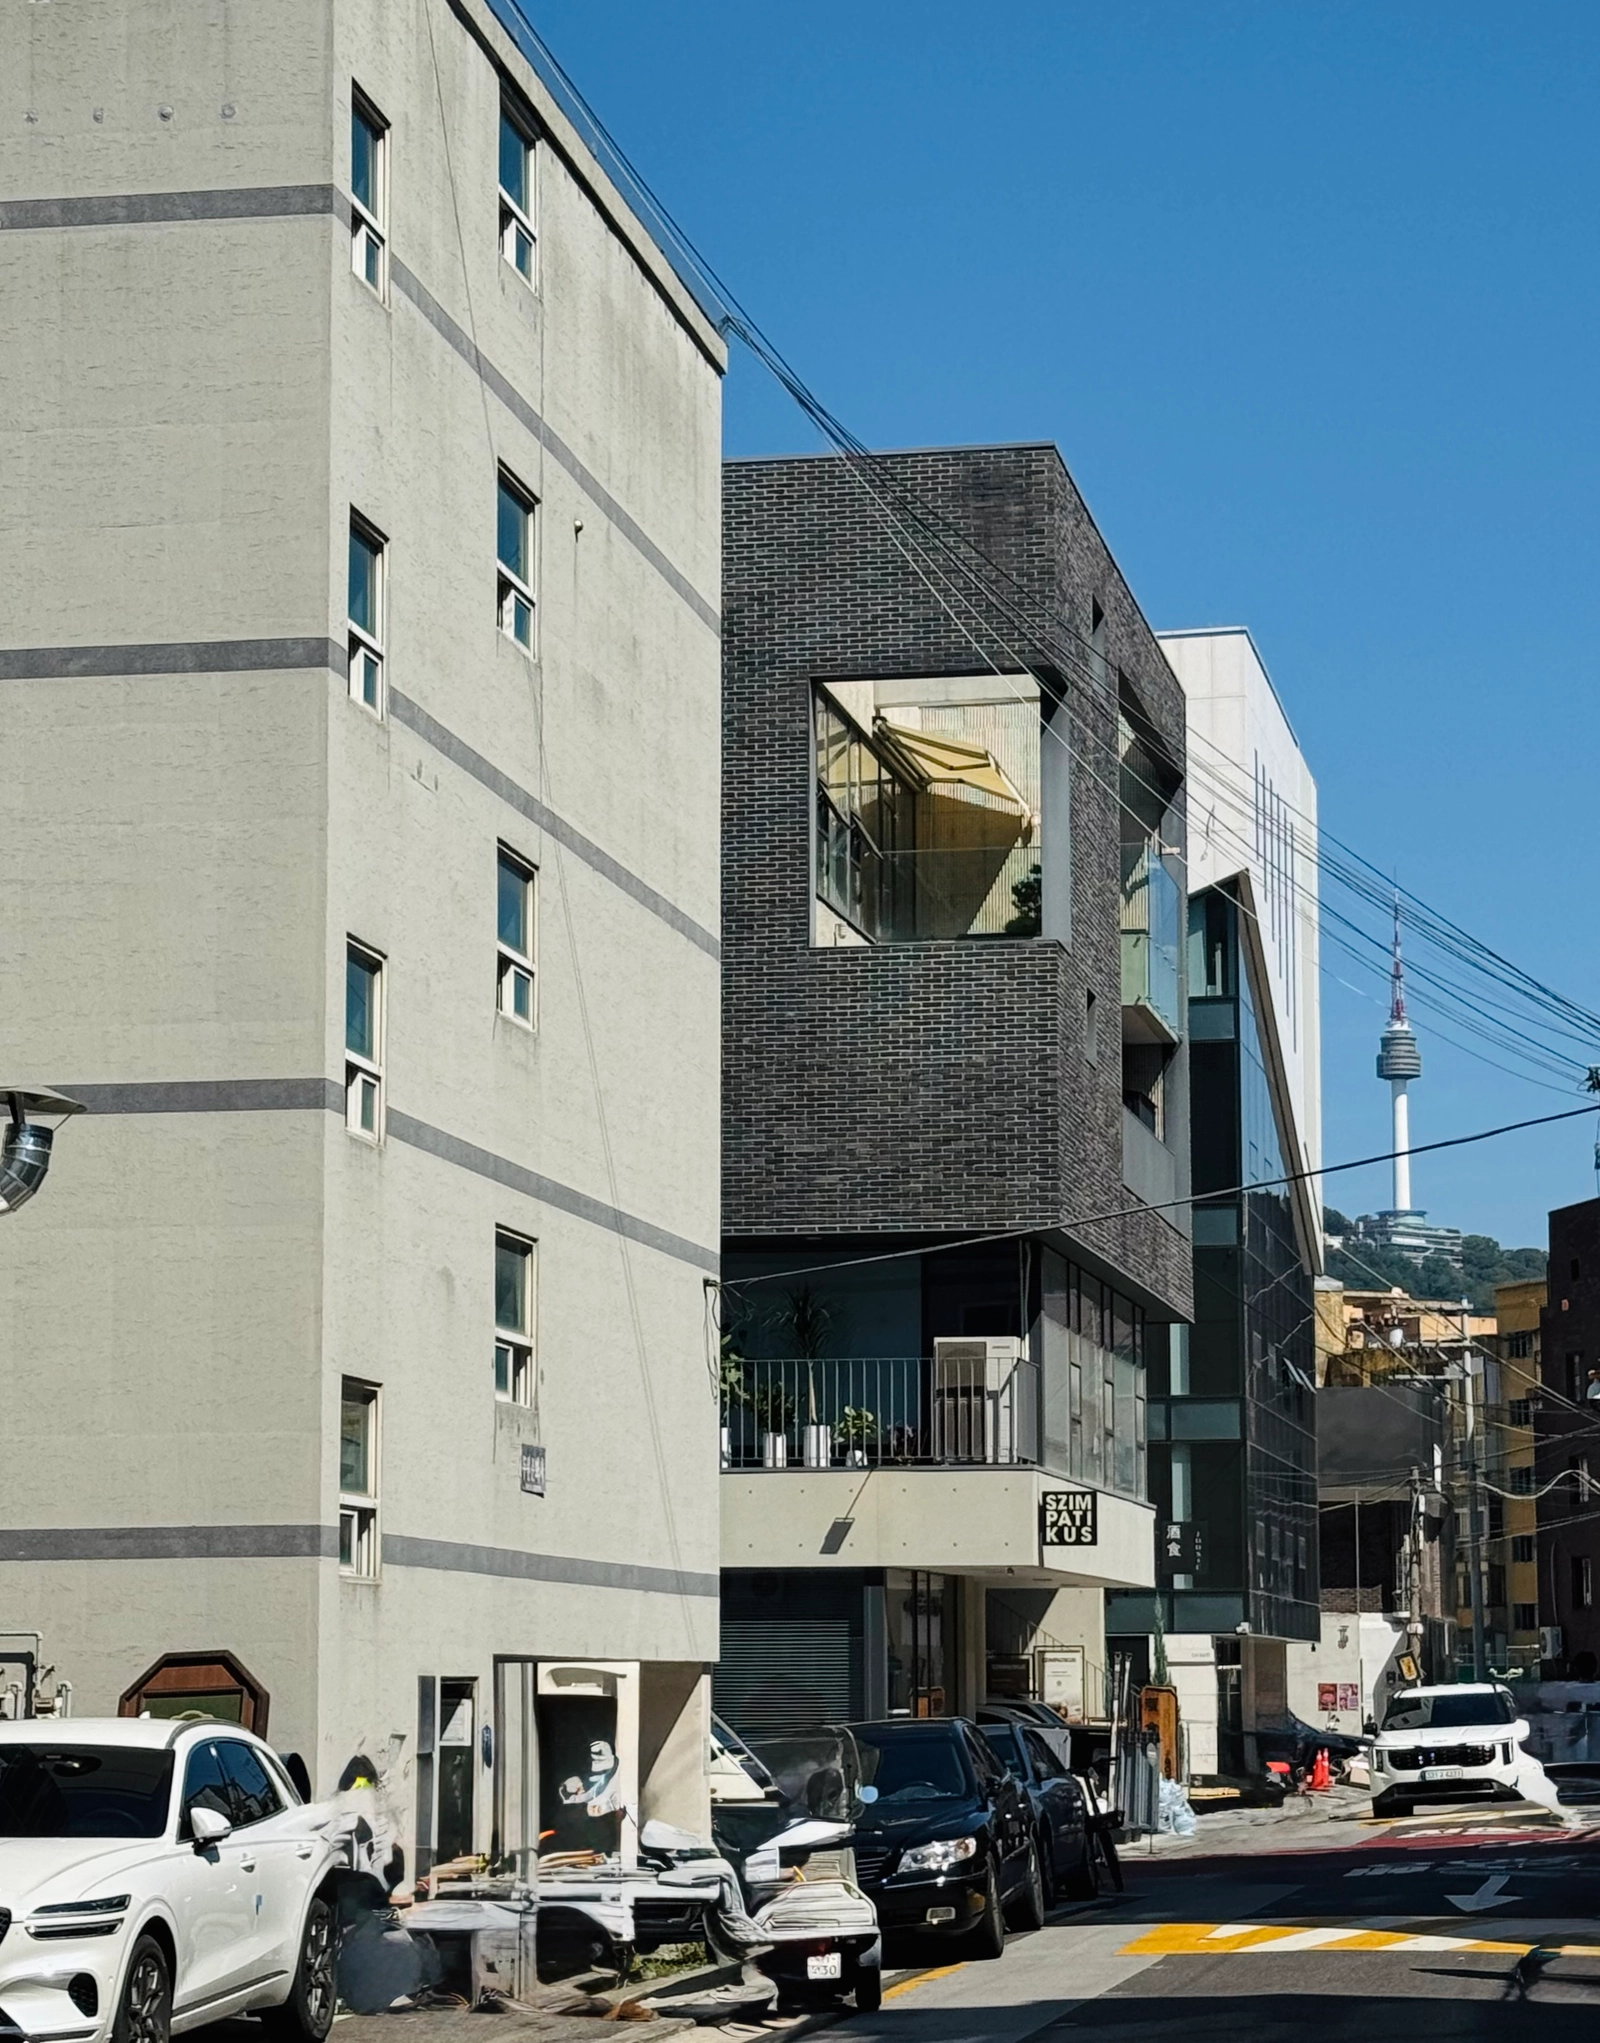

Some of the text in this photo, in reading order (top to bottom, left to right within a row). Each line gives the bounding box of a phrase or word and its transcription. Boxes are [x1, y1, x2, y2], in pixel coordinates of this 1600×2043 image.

[1045, 1494, 1092, 1510] SZIM
[1045, 1510, 1092, 1526] PATI
[1045, 1526, 1092, 1543] KUS
